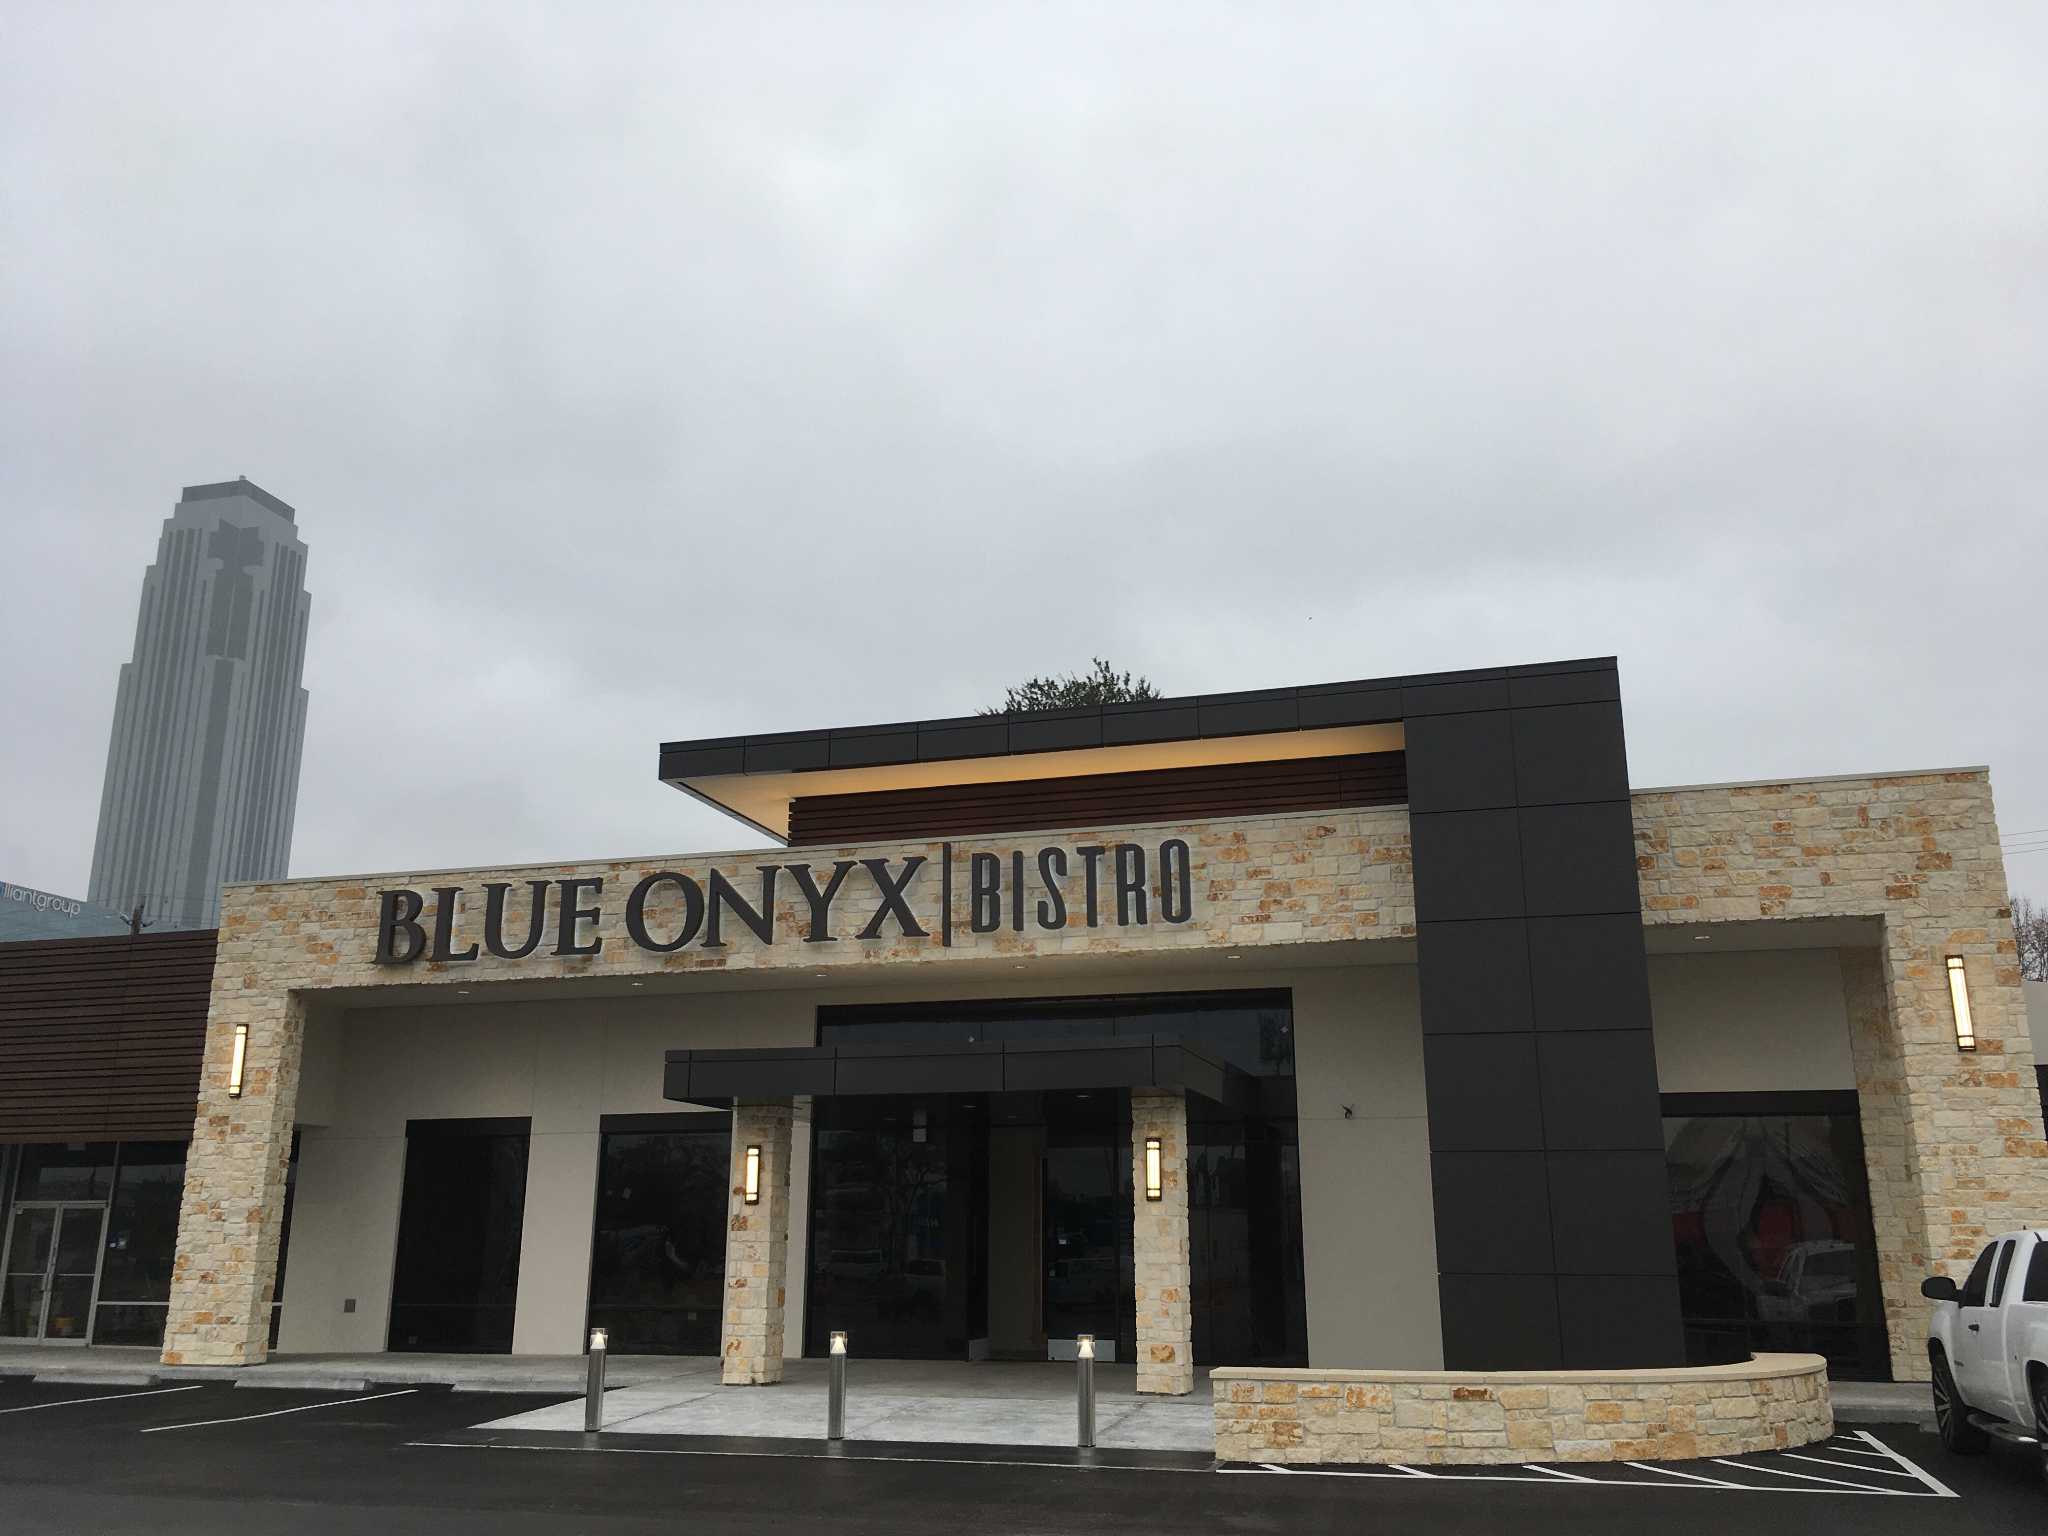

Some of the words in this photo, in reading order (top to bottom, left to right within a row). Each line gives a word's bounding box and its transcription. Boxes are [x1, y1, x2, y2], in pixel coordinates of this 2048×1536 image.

[1, 881, 81, 918] lliantgroup
[371, 876, 603, 966] BLUE
[625, 855, 931, 953] ONYX
[971, 838, 1192, 933] BISTRO
